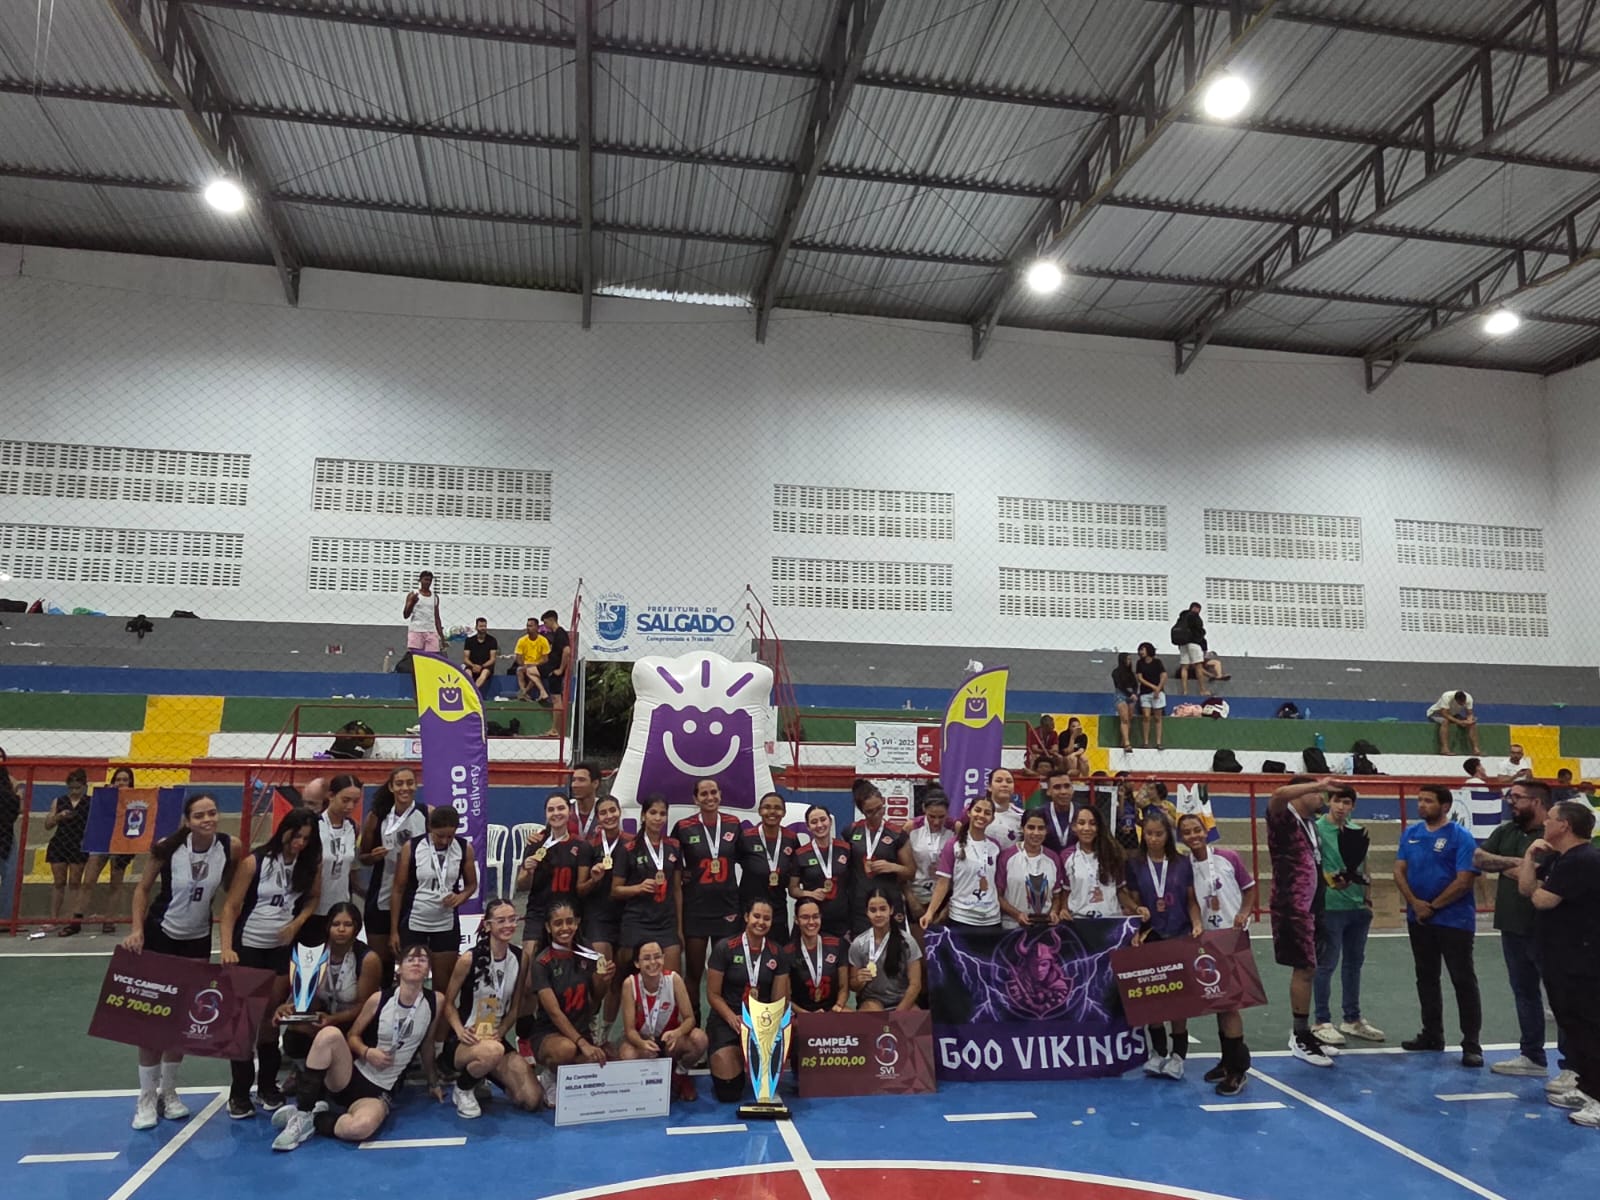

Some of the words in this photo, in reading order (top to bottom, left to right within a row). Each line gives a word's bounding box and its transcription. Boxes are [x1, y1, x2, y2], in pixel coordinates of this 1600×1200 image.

[636, 613, 735, 633] SALGADO
[470, 764, 481, 817] delivery
[551, 867, 572, 893] 10
[1117, 967, 1156, 980] TERCEIRO
[1156, 962, 1184, 973] LUGAR
[1128, 987, 1143, 999] R$
[1145, 980, 1184, 996] 500,00
[1204, 985, 1221, 995] SVI
[106, 993, 124, 1007] R$
[127, 997, 172, 1017] 700,00
[190, 1023, 209, 1034] SVI
[807, 1035, 859, 1047] CAMPEÃS
[938, 1036, 1004, 1071] GOO
[1012, 1026, 1147, 1070] VIKINGS
[819, 1047, 831, 1055] SVI
[832, 1047, 848, 1055] 2025
[801, 1056, 817, 1068] R$
[819, 1056, 866, 1068] 1.000,00
[879, 1066, 895, 1075] SVI
